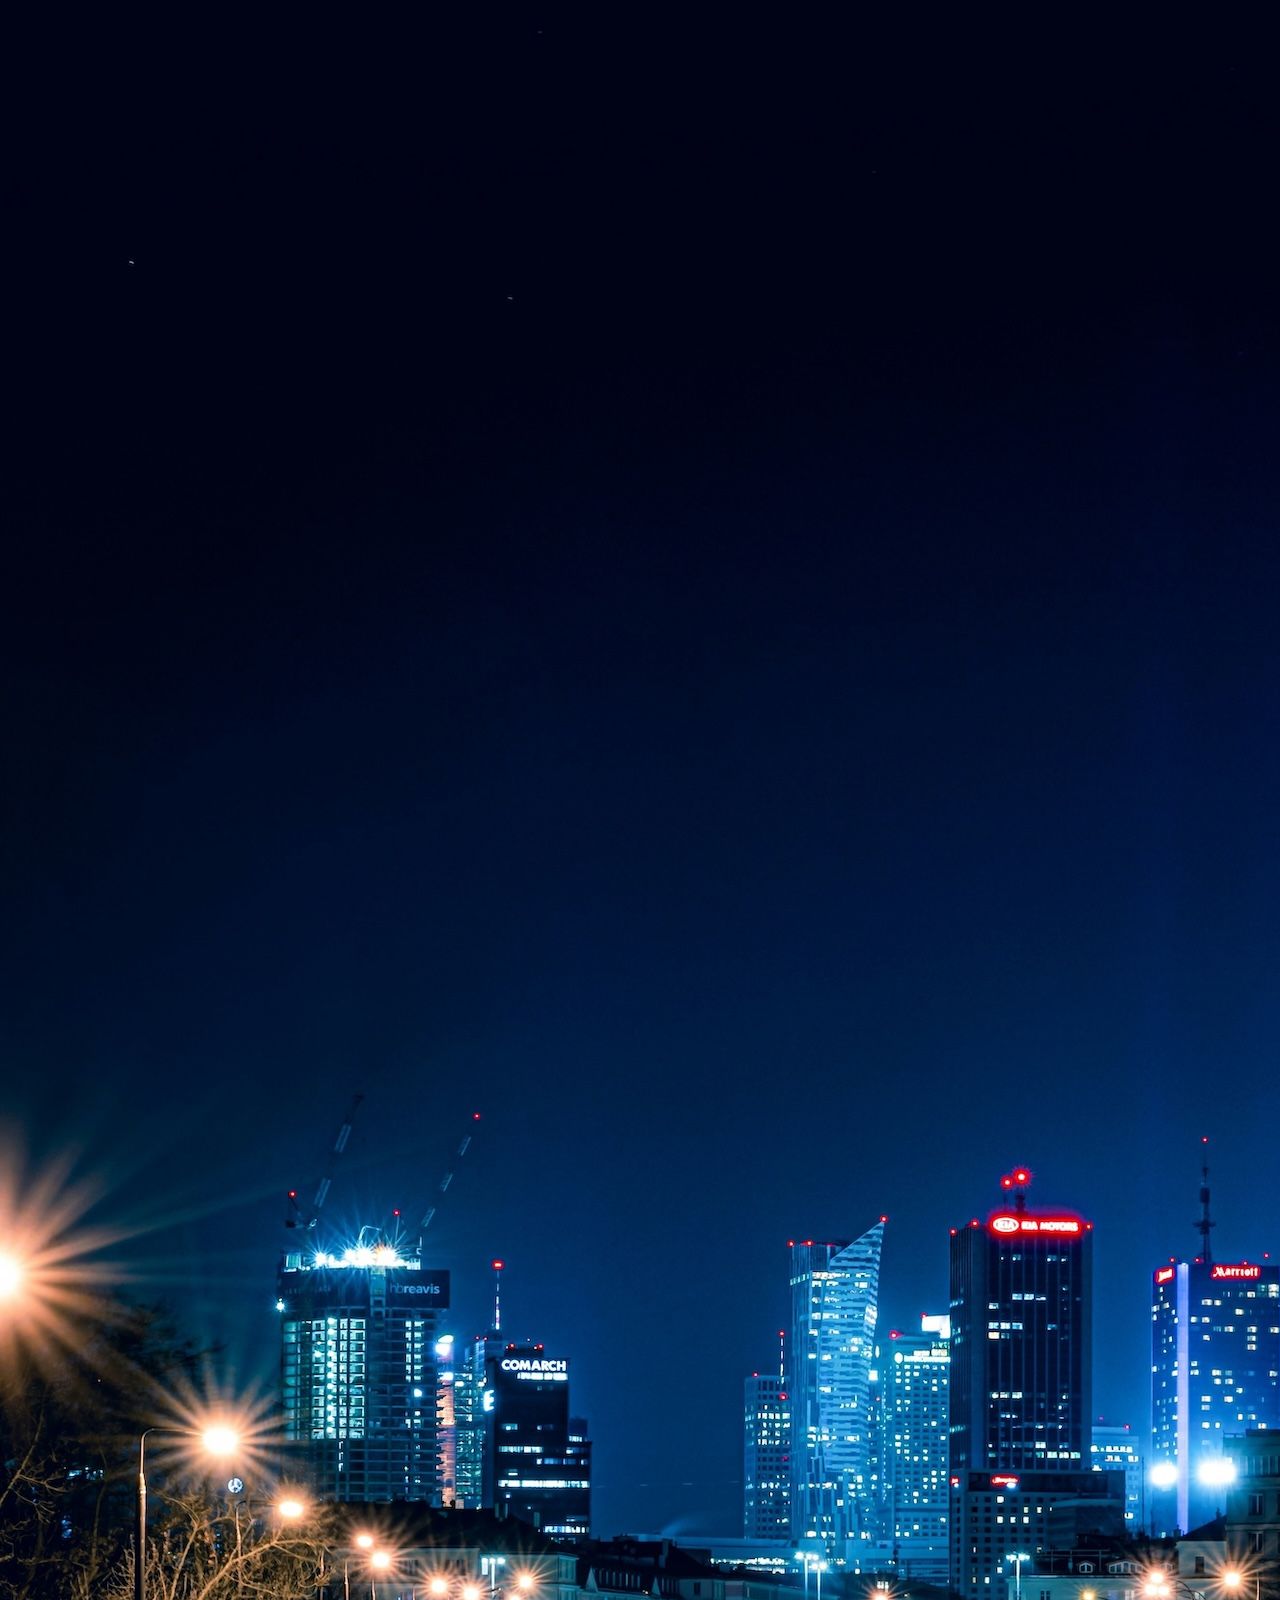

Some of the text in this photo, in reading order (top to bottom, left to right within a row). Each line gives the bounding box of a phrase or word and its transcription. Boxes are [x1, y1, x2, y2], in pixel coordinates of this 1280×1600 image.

[1021, 1221, 1078, 1231] KIA MOTORS
[1213, 1267, 1258, 1277] Marriott
[501, 1359, 566, 1371] COMARCH
